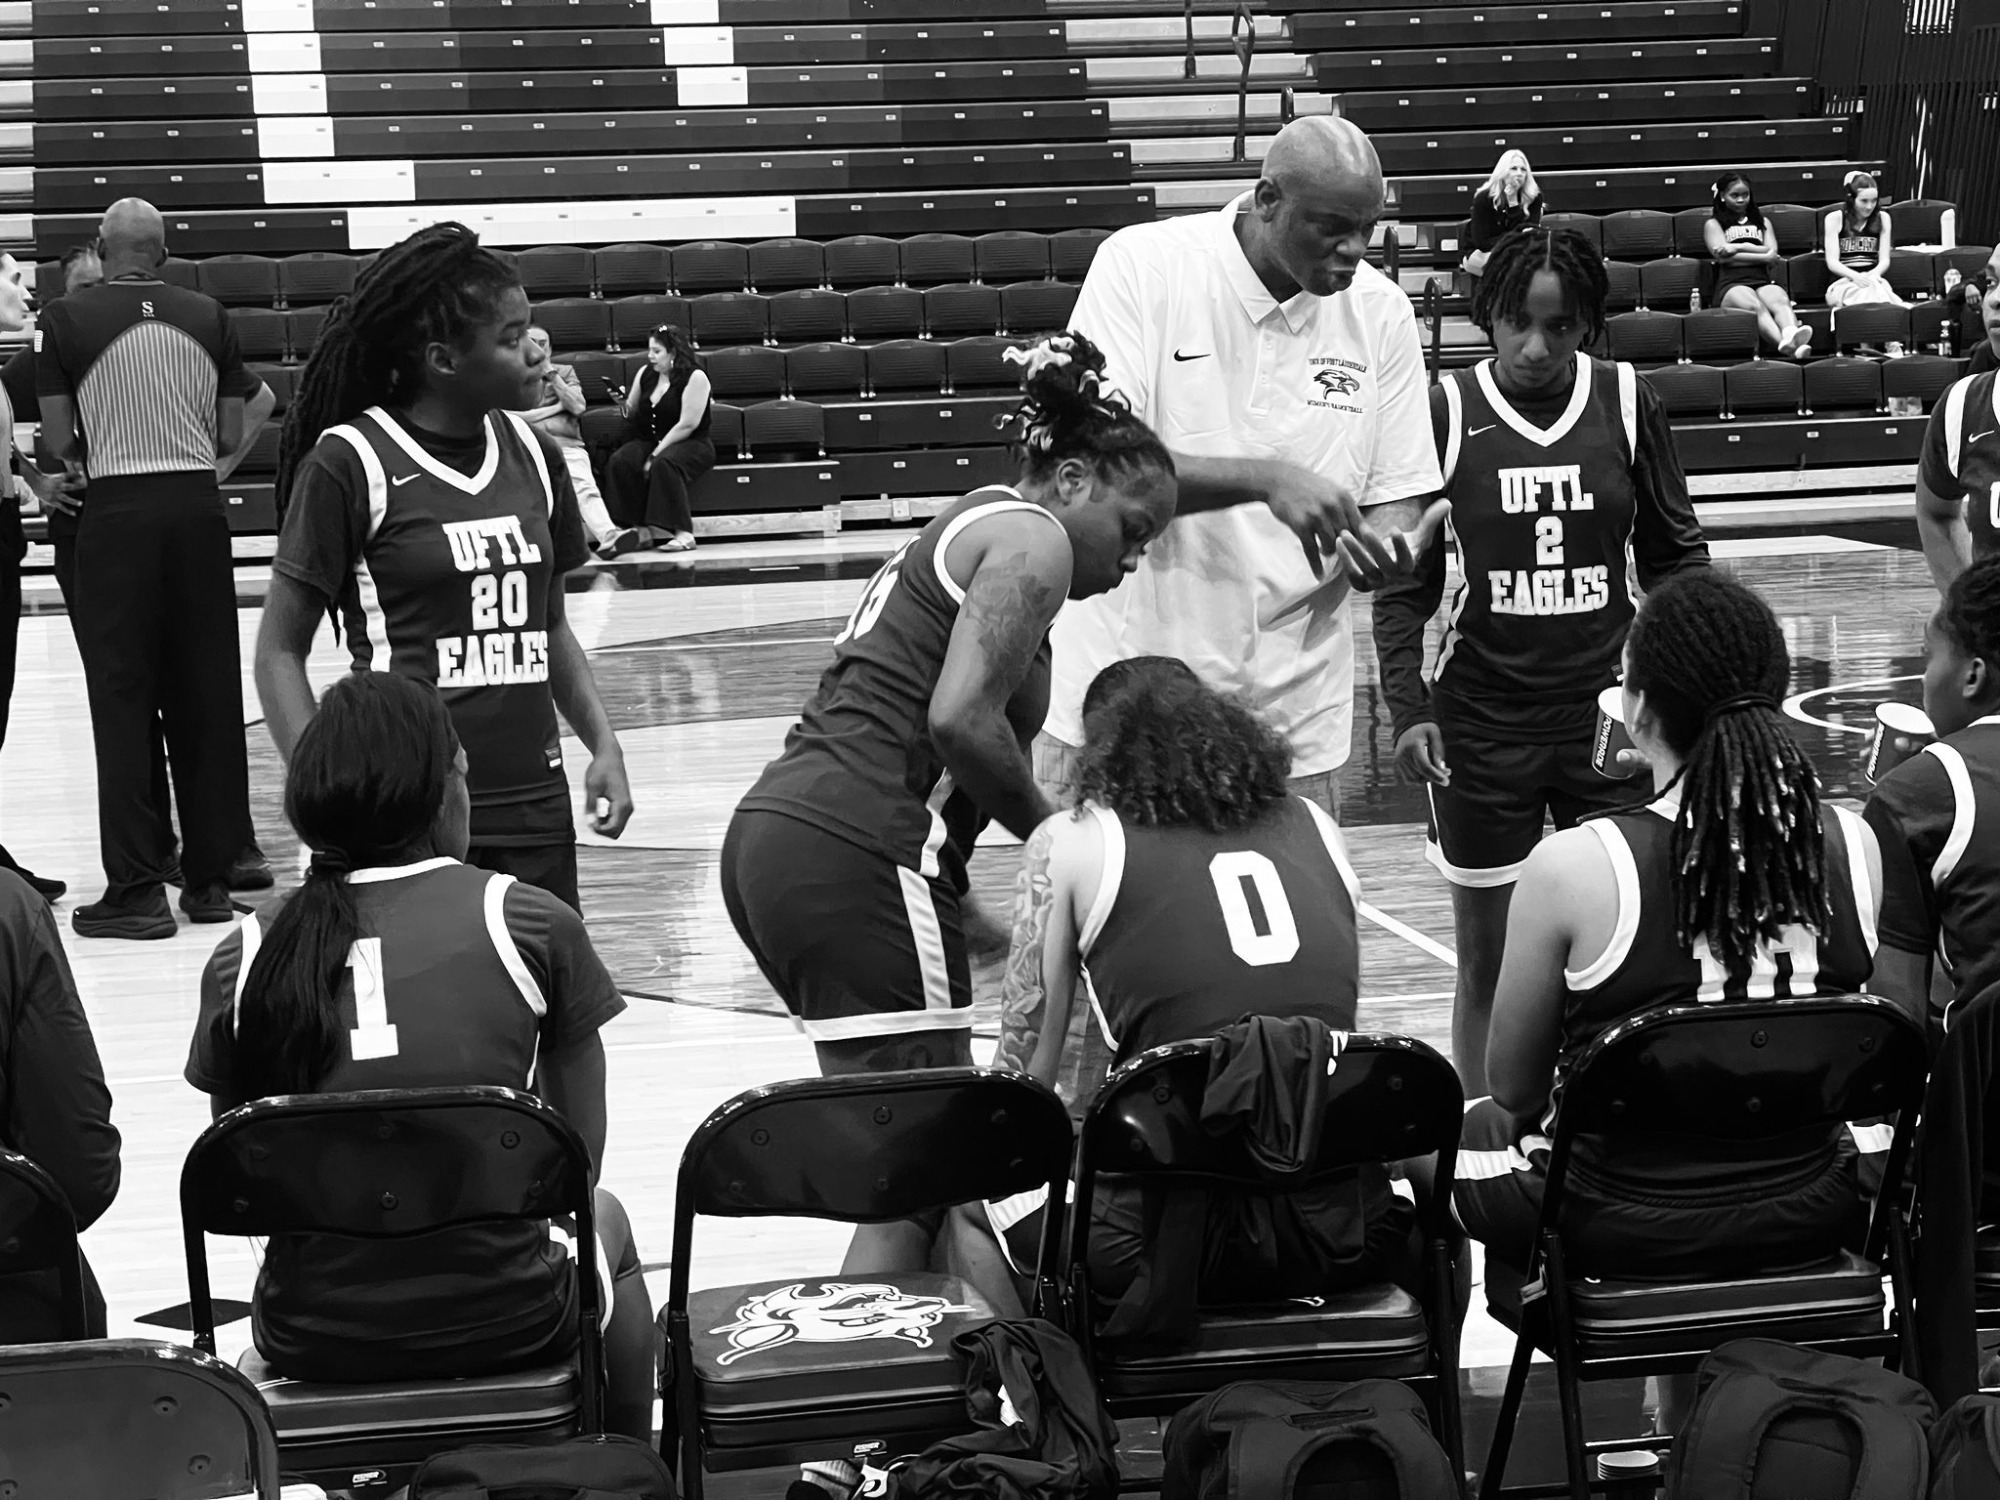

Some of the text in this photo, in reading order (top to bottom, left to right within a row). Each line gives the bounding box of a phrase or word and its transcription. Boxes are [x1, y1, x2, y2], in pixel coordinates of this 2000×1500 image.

[1498, 464, 1594, 514] UFTL
[441, 515, 542, 572] UFTL
[1535, 516, 1564, 566] 2
[471, 570, 528, 631] 20
[1488, 564, 1609, 616] EAGLES
[435, 630, 549, 688] EAGLES
[1595, 714, 1613, 768] POWERADE
[1208, 850, 1301, 967] 0
[345, 937, 399, 1061] 1
